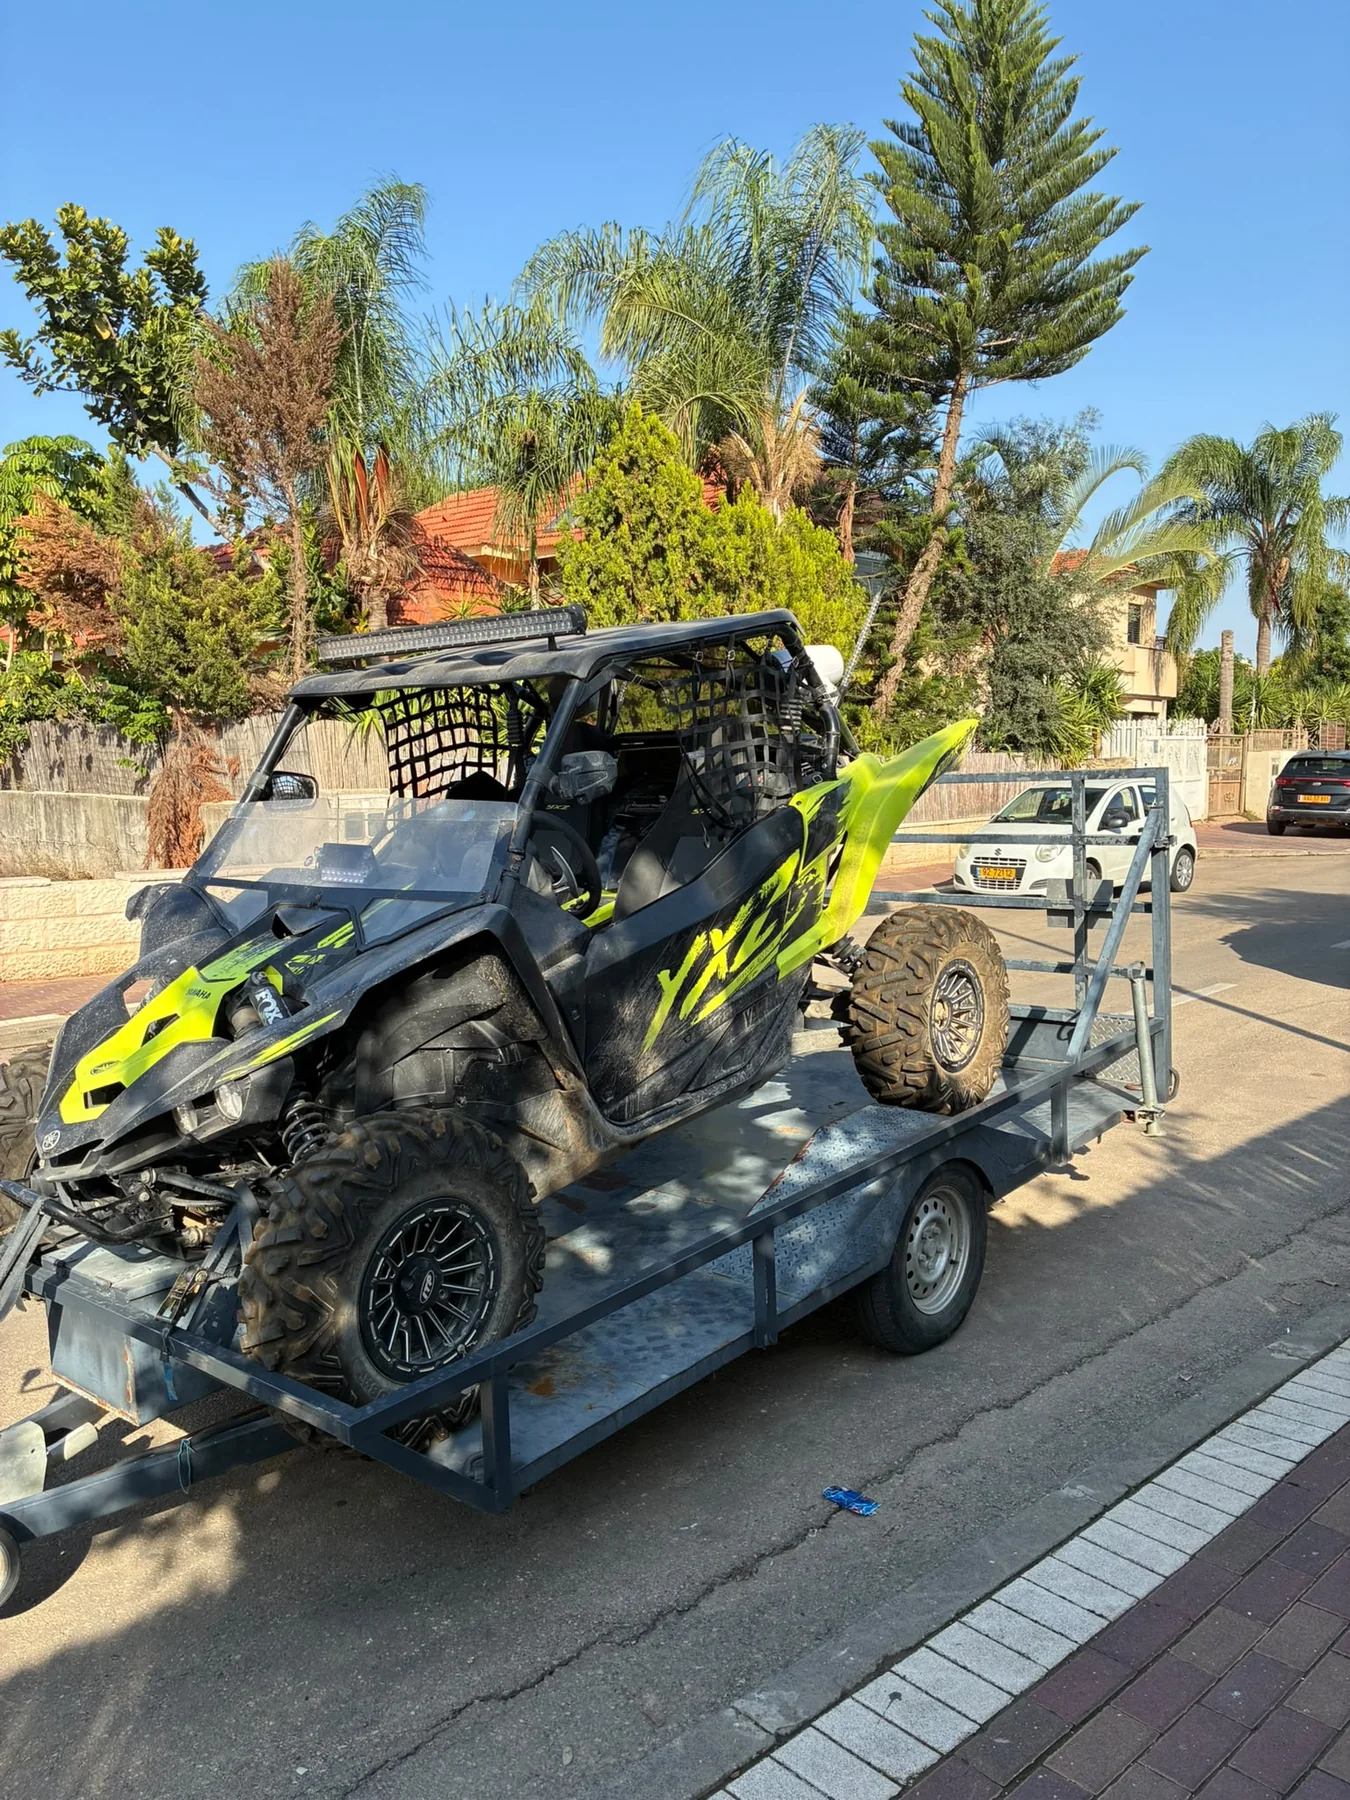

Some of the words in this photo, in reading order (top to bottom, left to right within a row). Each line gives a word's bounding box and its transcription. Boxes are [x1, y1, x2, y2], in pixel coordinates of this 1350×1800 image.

[186, 988, 211, 1000] YAMAHA
[254, 988, 284, 1025] FOX
[422, 1274, 432, 1299] ITP
